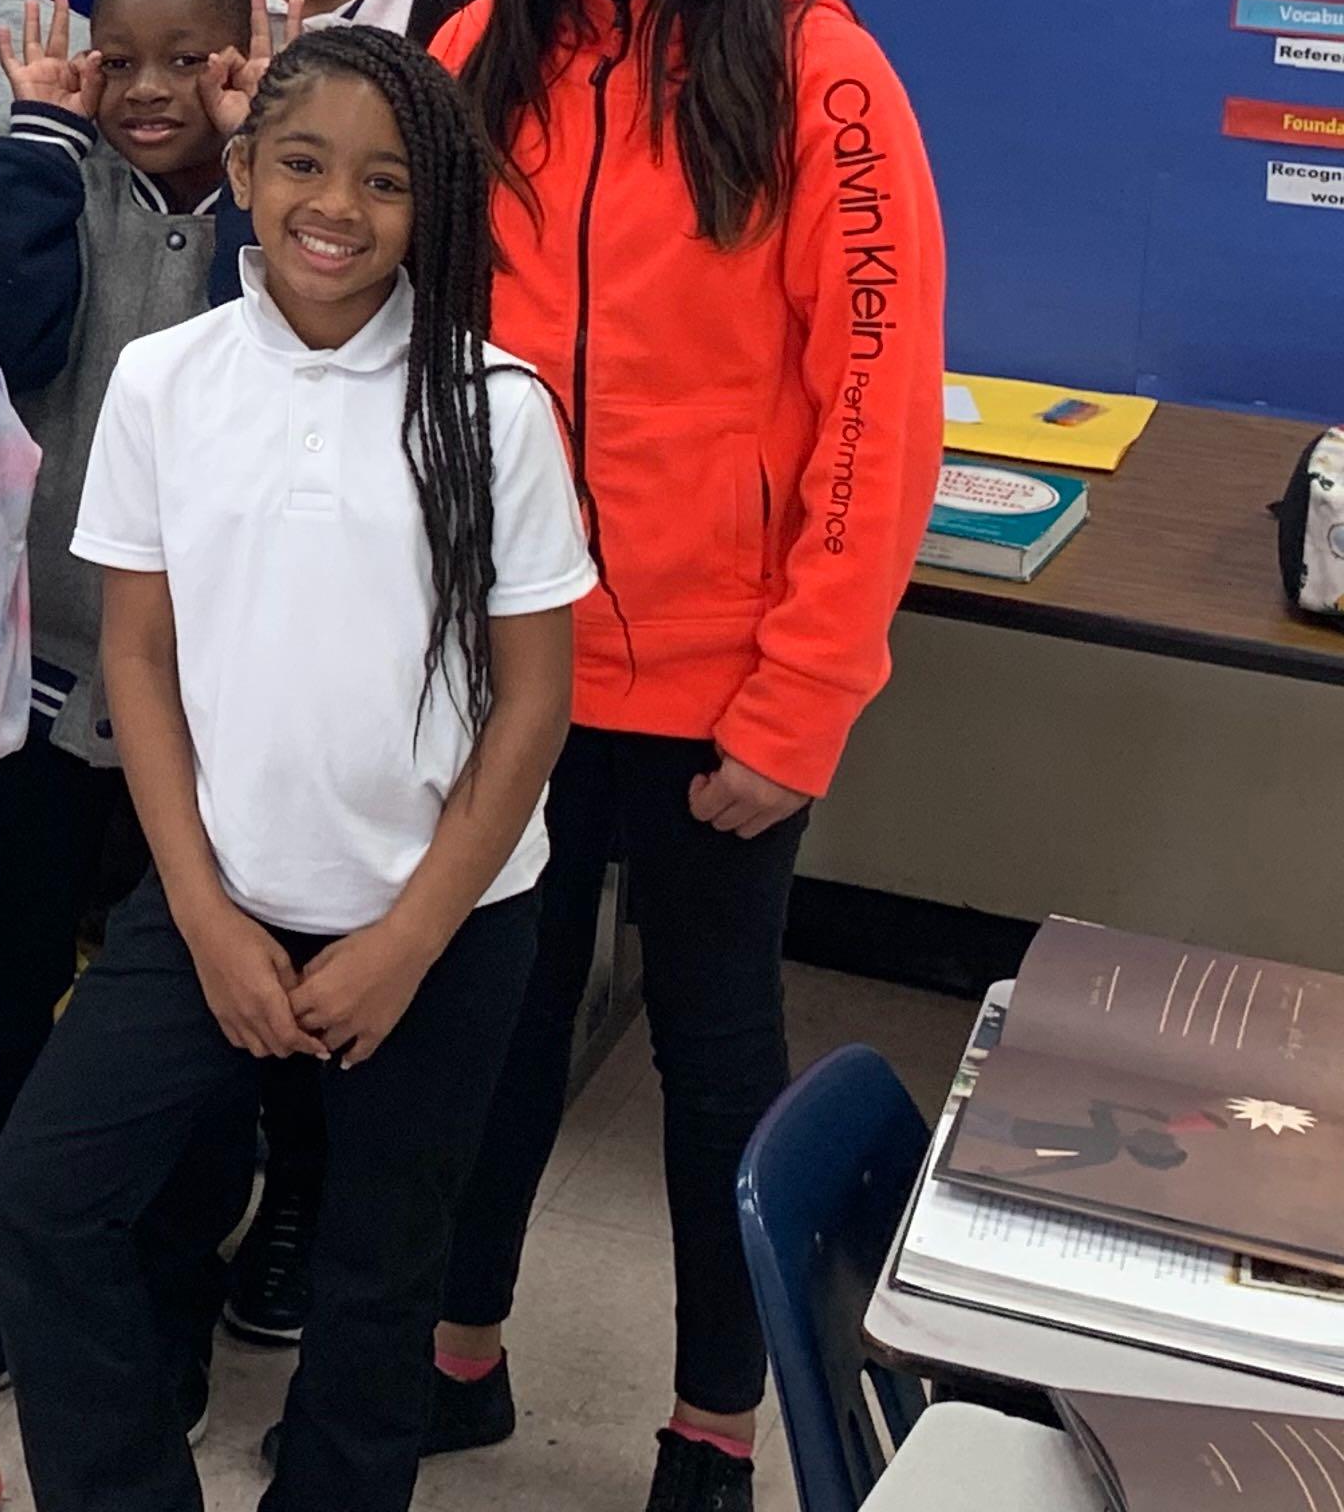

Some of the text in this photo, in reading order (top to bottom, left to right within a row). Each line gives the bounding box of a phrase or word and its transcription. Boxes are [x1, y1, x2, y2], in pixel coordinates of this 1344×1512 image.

[822, 77, 898, 556] Calvin Klein Performance
